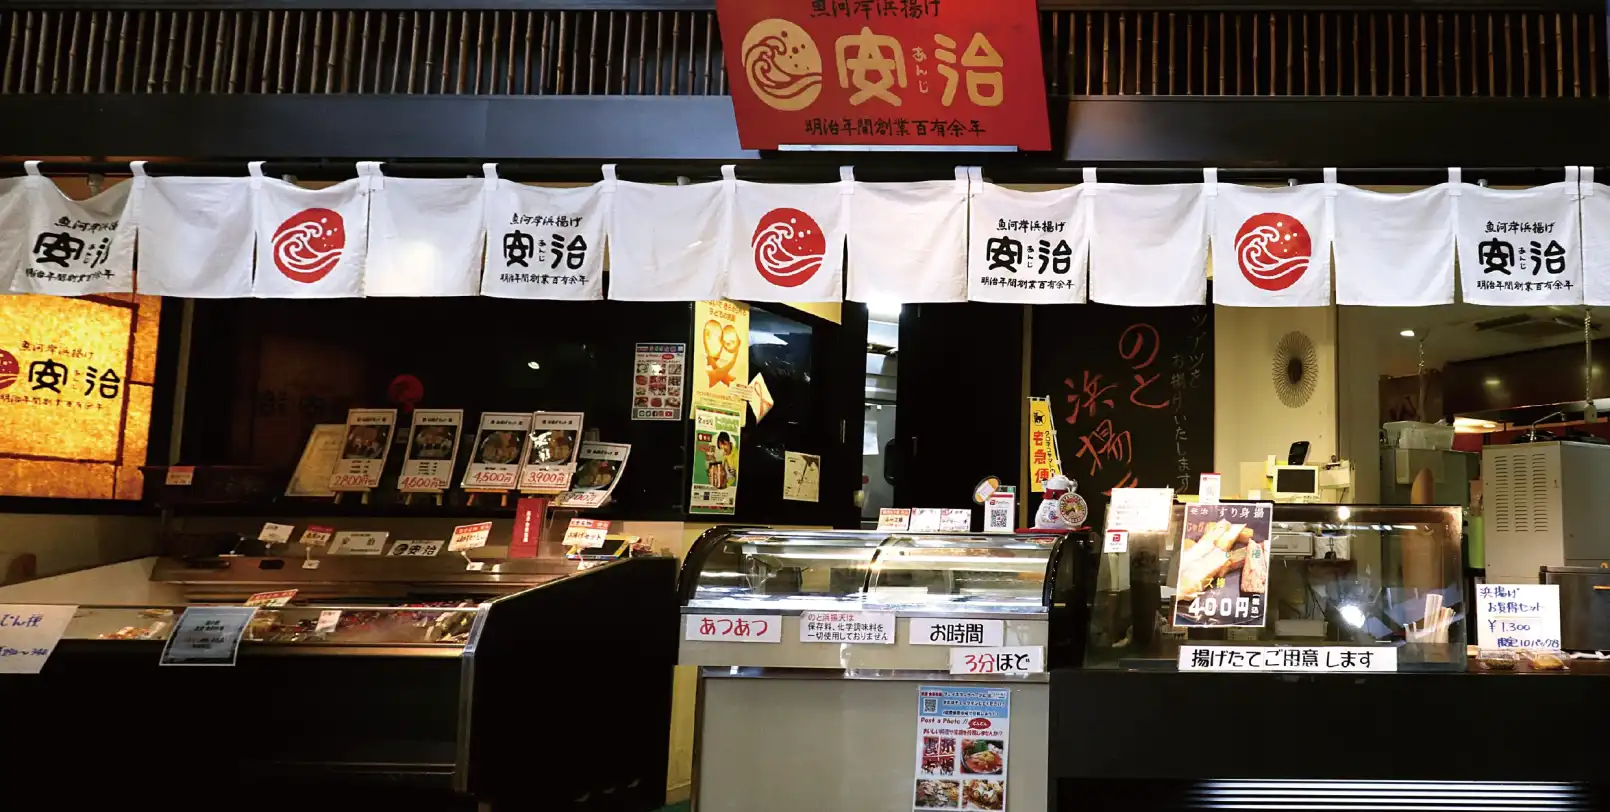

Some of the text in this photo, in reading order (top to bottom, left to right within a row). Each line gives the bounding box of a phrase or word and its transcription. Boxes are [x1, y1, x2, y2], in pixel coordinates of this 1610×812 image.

[911, 46, 930, 94] あんじ
[805, 118, 986, 138] 明治年間創業百有余年
[1119, 323, 1170, 409] のと
[1033, 430, 1049, 483] 宅急便
[1188, 597, 1250, 618] 400円
[699, 616, 768, 637] あつあつ
[807, 622, 884, 632] 保存料、化学調味料を
[807, 632, 888, 641] 一切使用しておりません
[929, 623, 984, 644] お時間
[964, 651, 1031, 673] 3分ほど
